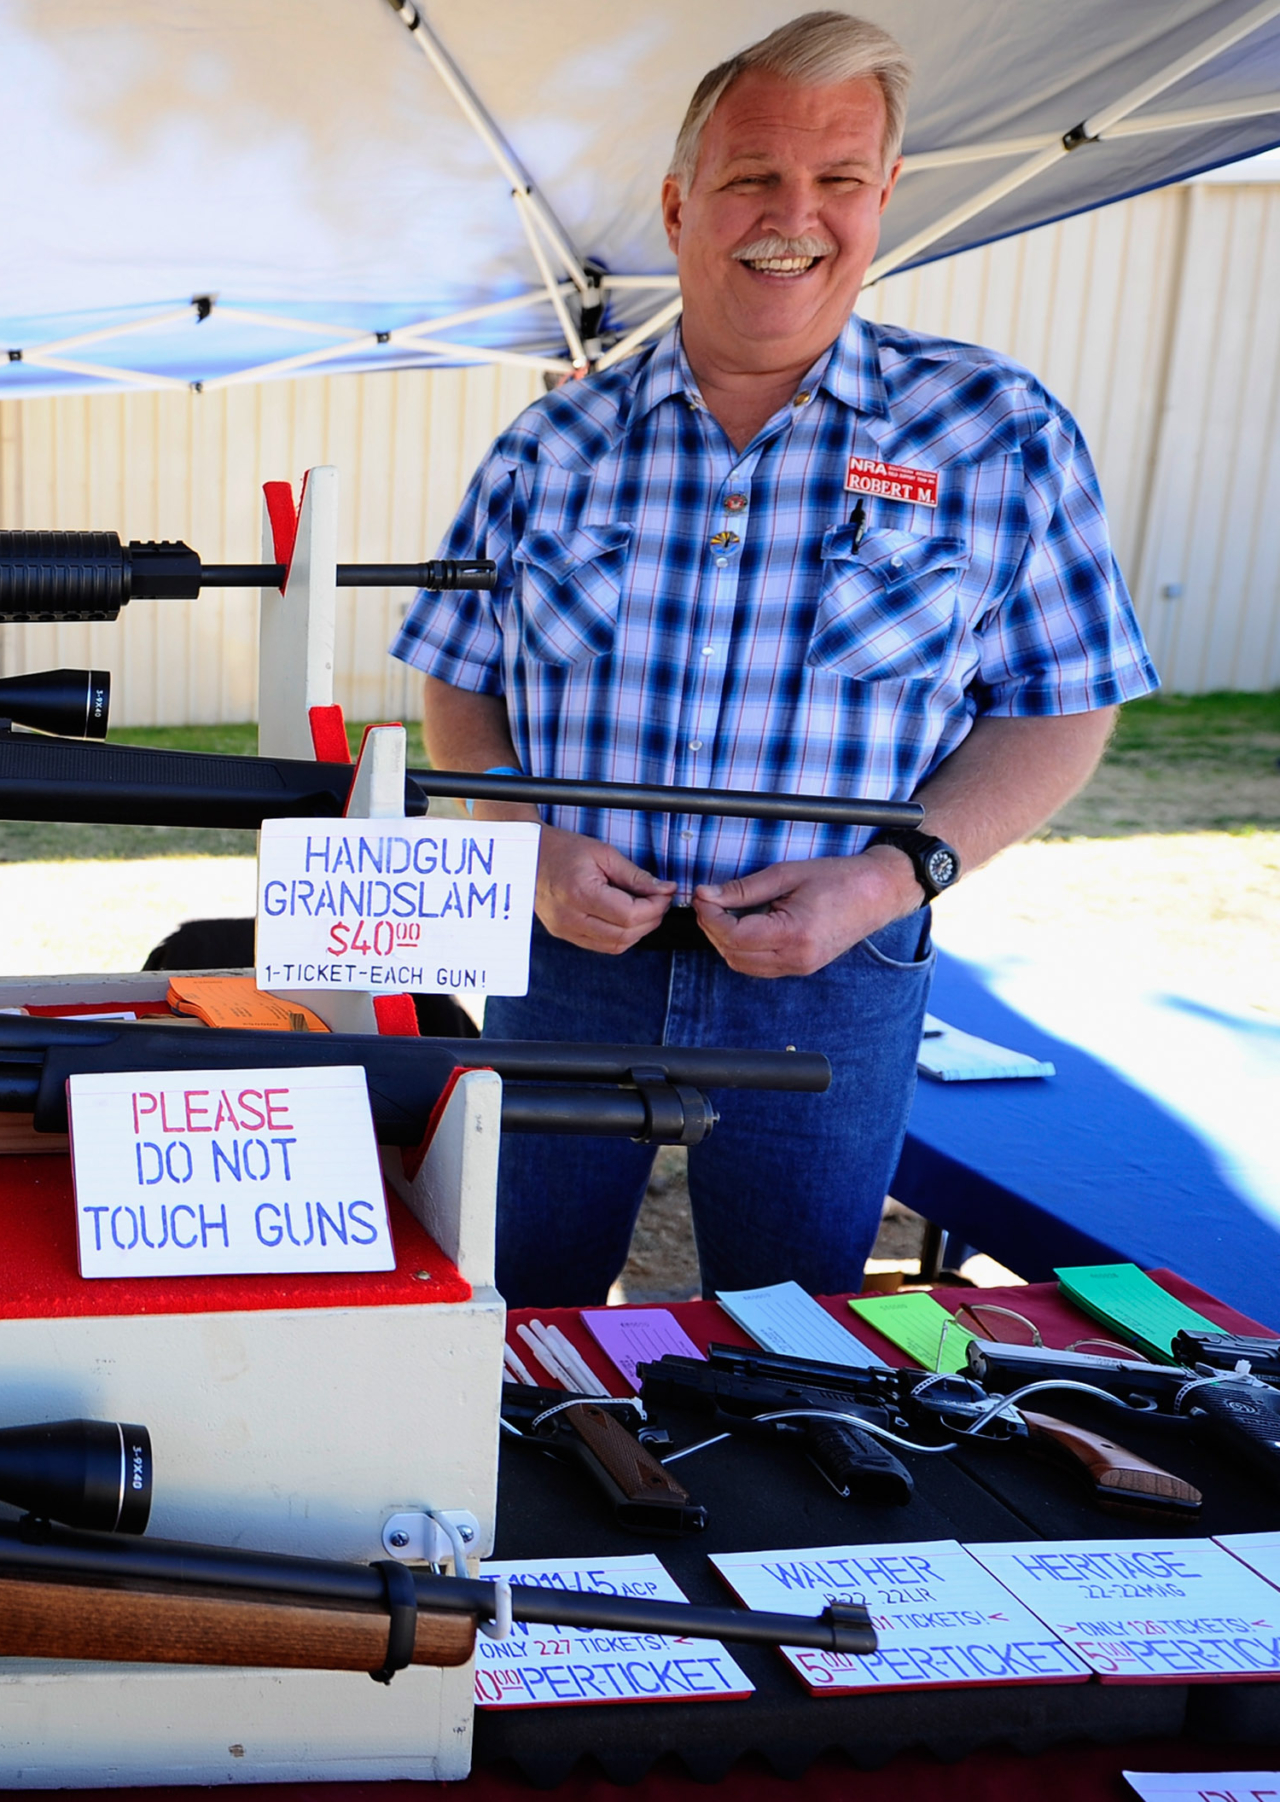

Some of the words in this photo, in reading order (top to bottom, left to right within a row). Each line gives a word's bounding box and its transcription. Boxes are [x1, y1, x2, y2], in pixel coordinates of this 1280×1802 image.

[851, 458, 887, 476] NRA
[849, 473, 913, 499] ROBERT
[917, 487, 935, 503] M.
[305, 836, 495, 876] HANDGUN
[264, 880, 511, 920] GRANDSLAM!
[265, 964, 423, 985] 1-TICKET-EACH
[437, 968, 486, 988] GUN!
[132, 1088, 294, 1134] PLEASE
[136, 1140, 193, 1185] DO
[212, 1138, 297, 1182] NOT
[83, 1204, 229, 1250] TOUCH
[255, 1200, 378, 1247] GUNS
[132, 1445, 143, 1489] 3-9X40
[761, 1556, 946, 1590] WALTHER
[1011, 1551, 1203, 1581] HERITAGE
[621, 1581, 658, 1597] ACP
[891, 1610, 990, 1631] TICKETS!
[1076, 1620, 1131, 1637] ONLY
[1126, 1619, 1168, 1636] 126
[1158, 1617, 1257, 1635] TICKETS!
[480, 1641, 529, 1659] ONLY
[533, 1640, 571, 1656] 227
[574, 1633, 669, 1654] TICKETS!
